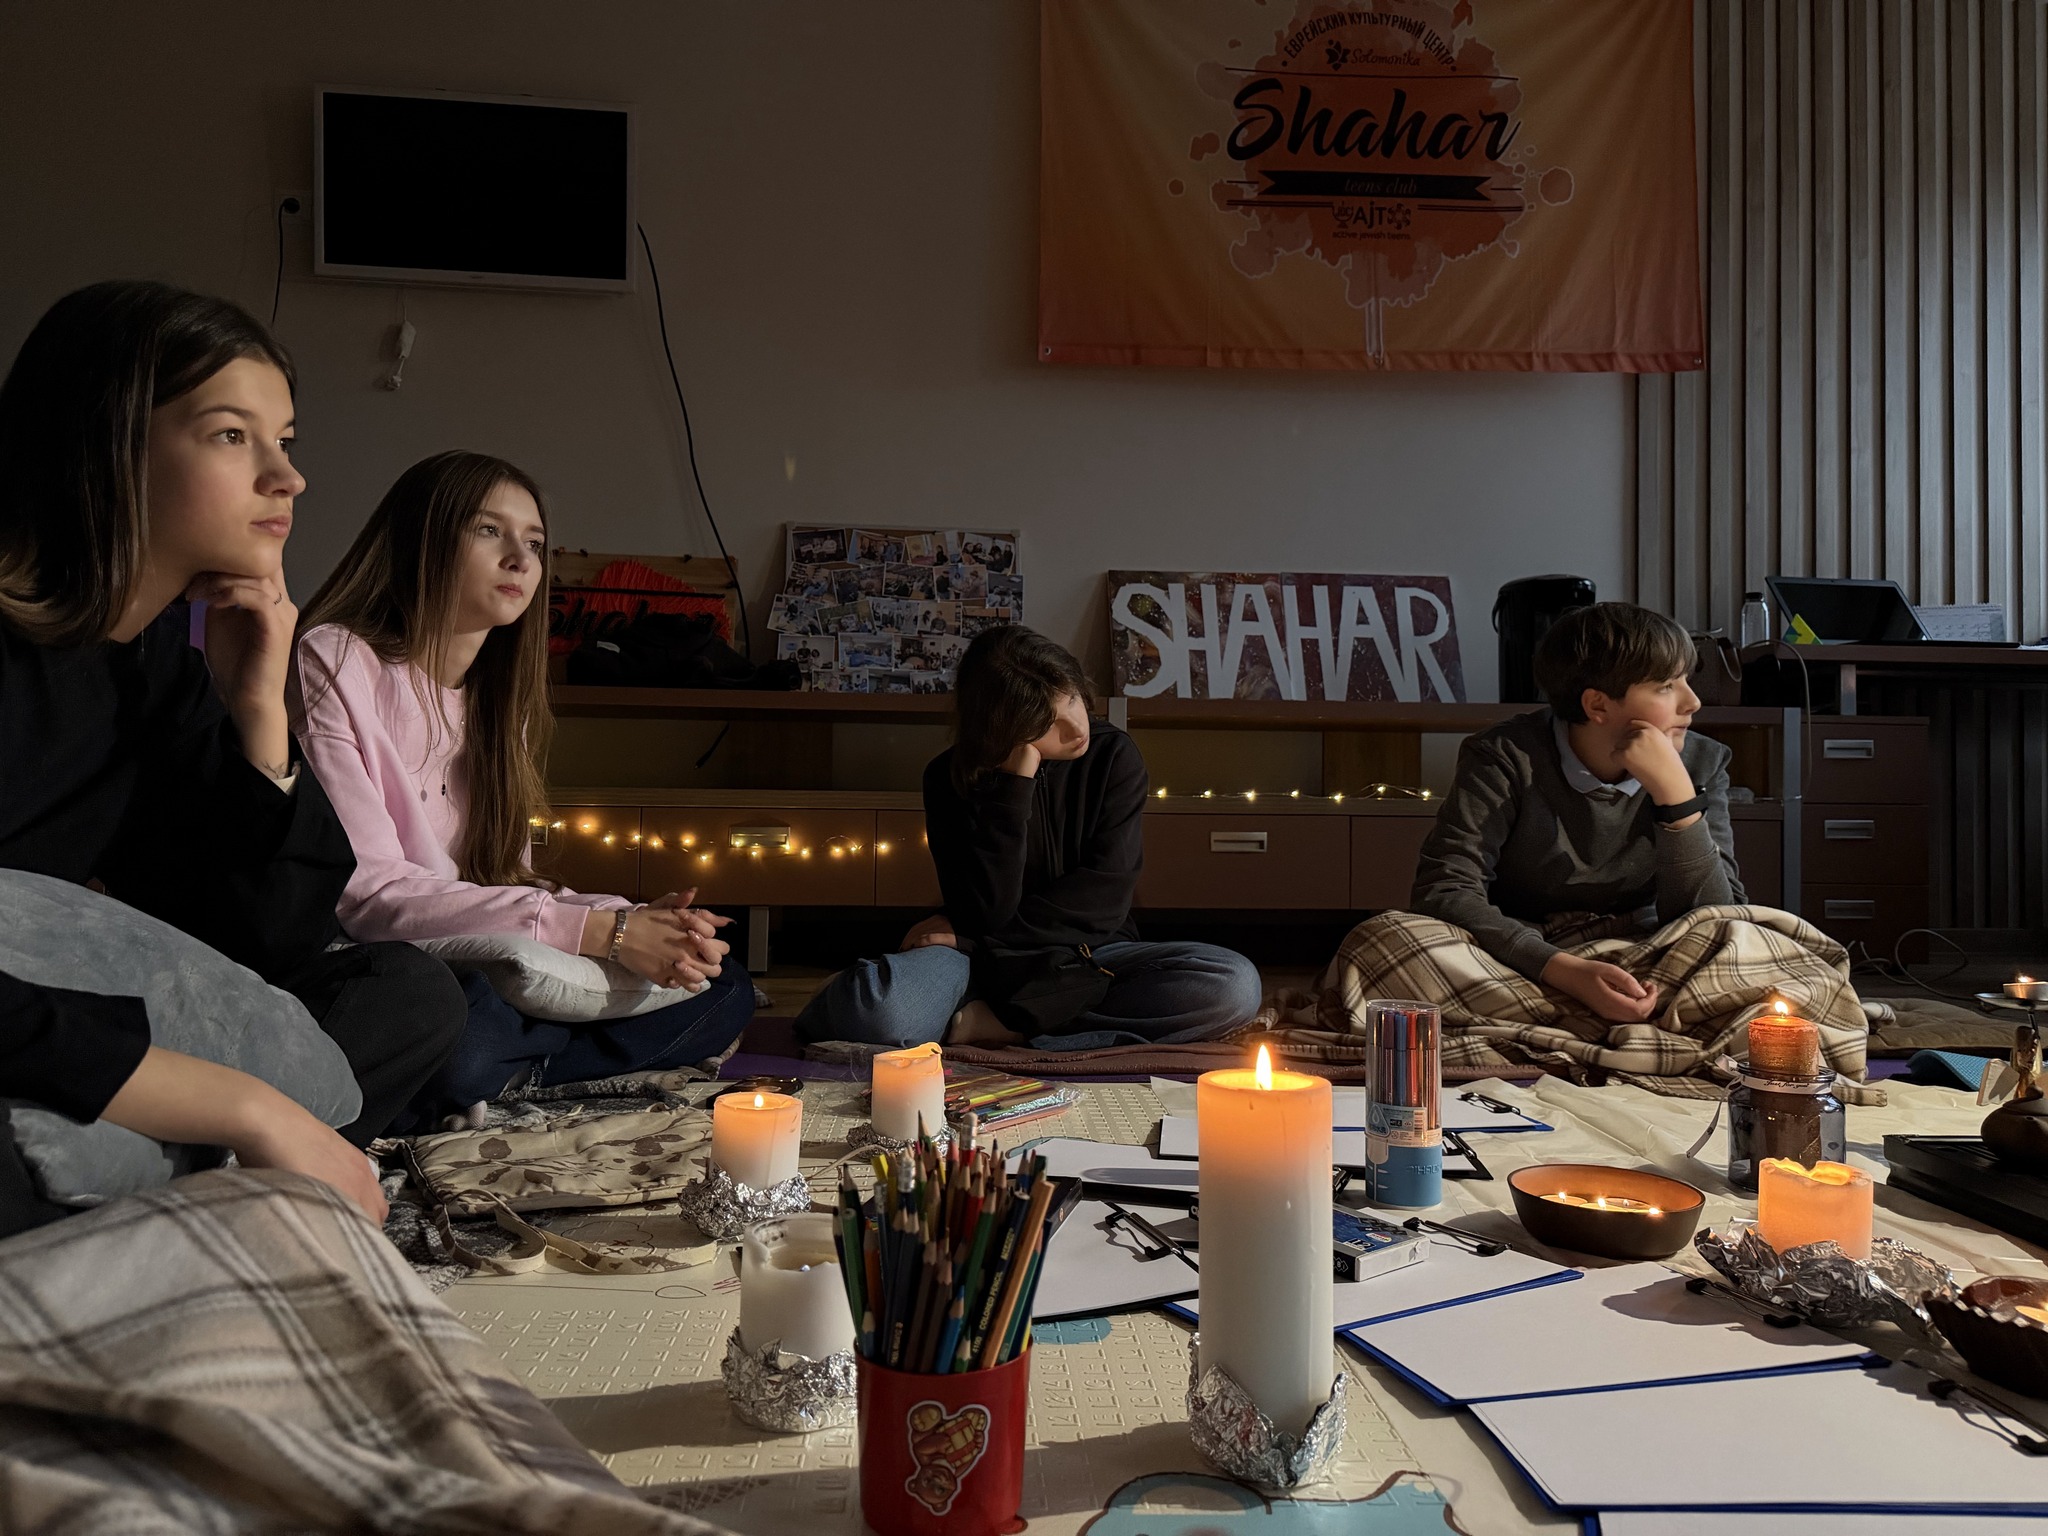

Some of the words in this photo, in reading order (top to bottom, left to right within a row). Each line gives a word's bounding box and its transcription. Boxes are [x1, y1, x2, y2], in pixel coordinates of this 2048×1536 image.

[1284, 12, 1348, 58] ЕВРЕЙСКИЙ
[1422, 29, 1455, 65] ЦЕНТР
[1227, 78, 1521, 161] Shahar
[1112, 582, 1457, 704] SHAHAR
